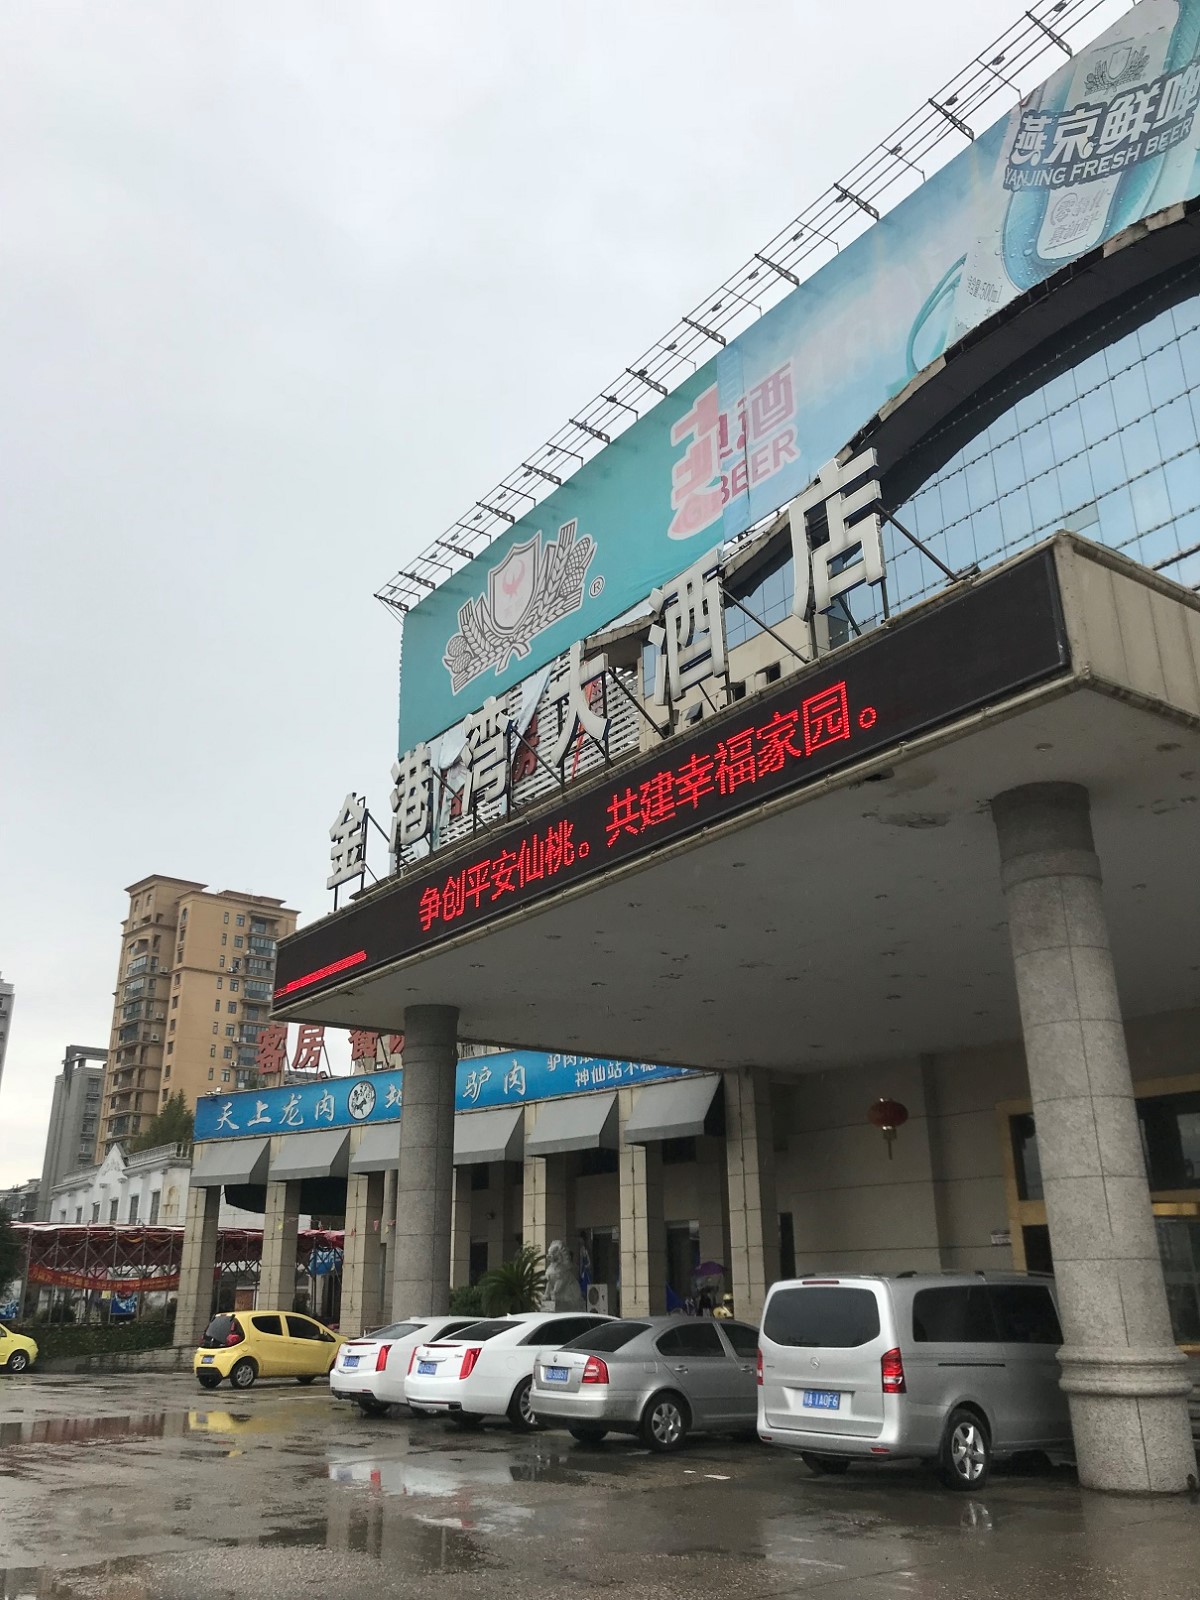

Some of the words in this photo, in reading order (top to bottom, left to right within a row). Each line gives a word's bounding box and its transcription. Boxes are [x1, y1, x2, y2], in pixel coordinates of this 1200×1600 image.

[1004, 167, 1066, 187] YANJING
[1069, 145, 1140, 183] FRESH
[1144, 118, 1193, 158] BEER
[326, 447, 886, 890] 金港湾大酒店
[256, 1023, 325, 1075] 客房
[214, 1088, 336, 1132] 天上龙肉
[462, 1058, 528, 1104] 驴肉
